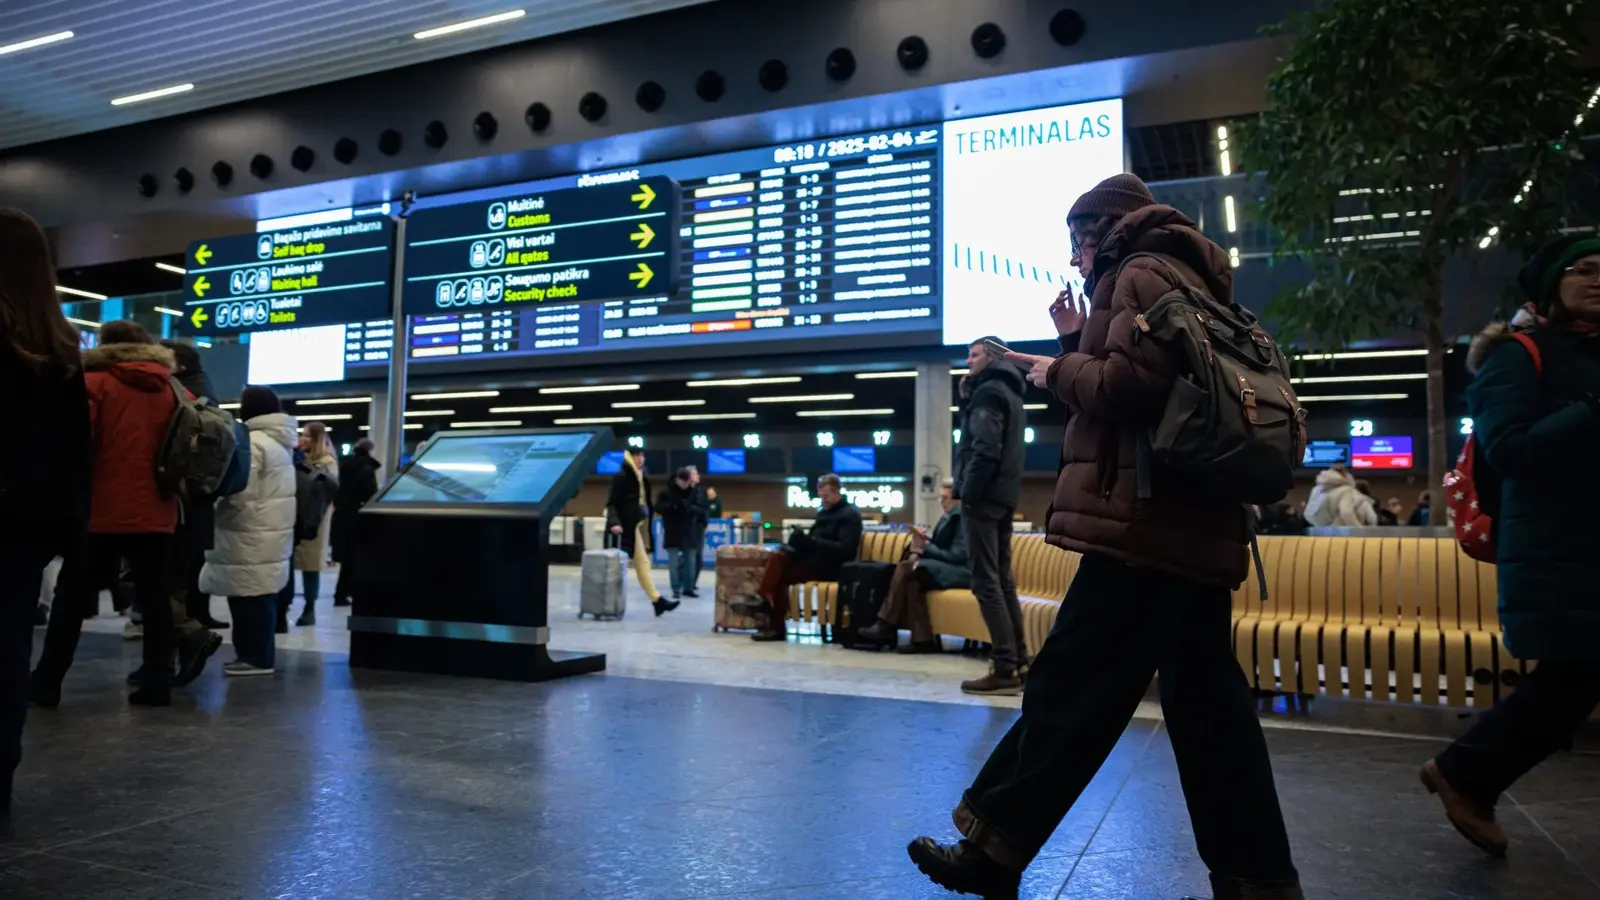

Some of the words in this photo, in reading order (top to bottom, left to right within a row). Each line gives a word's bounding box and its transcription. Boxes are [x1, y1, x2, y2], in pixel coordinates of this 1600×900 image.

[956, 114, 1111, 154] TERMINALAS
[827, 131, 913, 156] 2025-02-04
[507, 196, 545, 213] Muitinė
[507, 213, 551, 228] Customs
[303, 225, 343, 243] pridavimo
[343, 220, 383, 235] savitarna
[506, 235, 525, 249] Visi
[525, 231, 556, 248] vartai
[273, 245, 290, 258] Self
[290, 244, 306, 256] bag
[305, 242, 326, 255] drop
[505, 251, 520, 265] All
[520, 250, 550, 266] gates
[271, 263, 306, 278] Laukimo
[504, 273, 552, 288] Saugumo
[552, 266, 590, 285] patikra
[271, 277, 302, 291] Waiting
[301, 274, 318, 287] hall
[504, 288, 546, 302] Security
[546, 283, 578, 299] check
[270, 295, 303, 310] Tualetai
[269, 311, 297, 323] Toilets
[1350, 420, 1374, 436] 23
[872, 430, 891, 446] 17
[787, 485, 904, 513] Reracija
